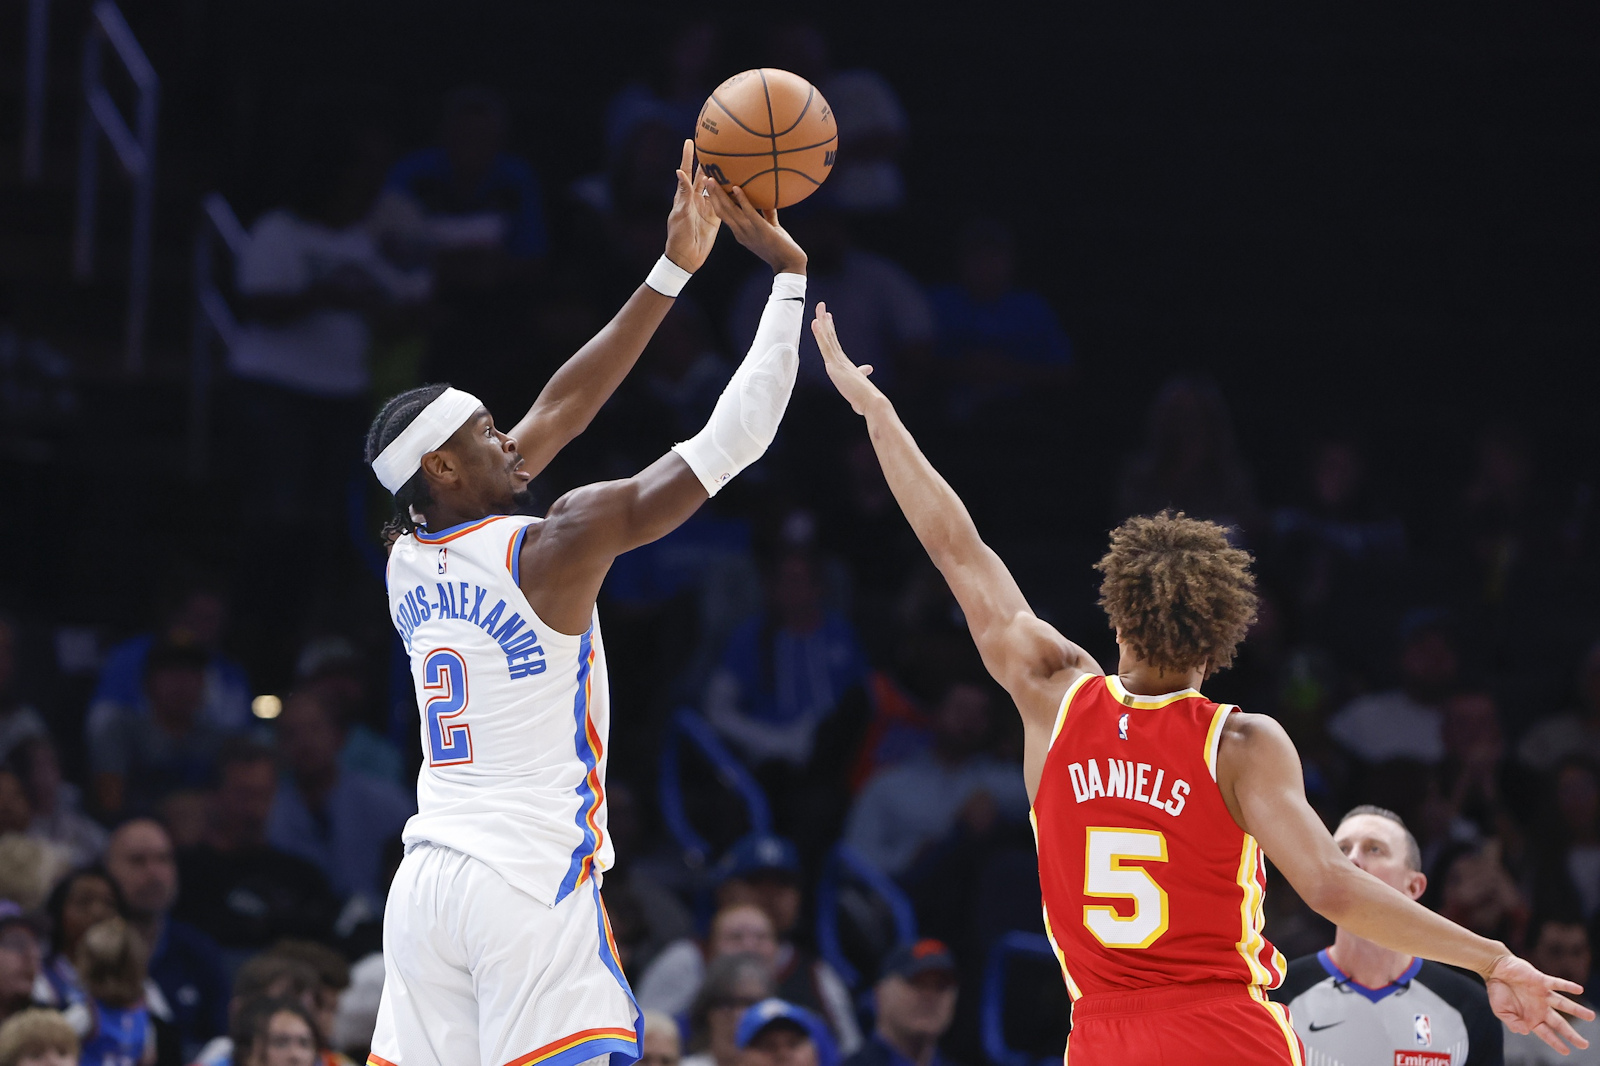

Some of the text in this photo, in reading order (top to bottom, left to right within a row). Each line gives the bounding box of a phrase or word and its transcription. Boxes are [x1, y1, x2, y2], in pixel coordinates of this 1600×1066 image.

[423, 648, 473, 767] 2
[1068, 758, 1191, 816] DANIELS
[1083, 826, 1169, 949] 5
